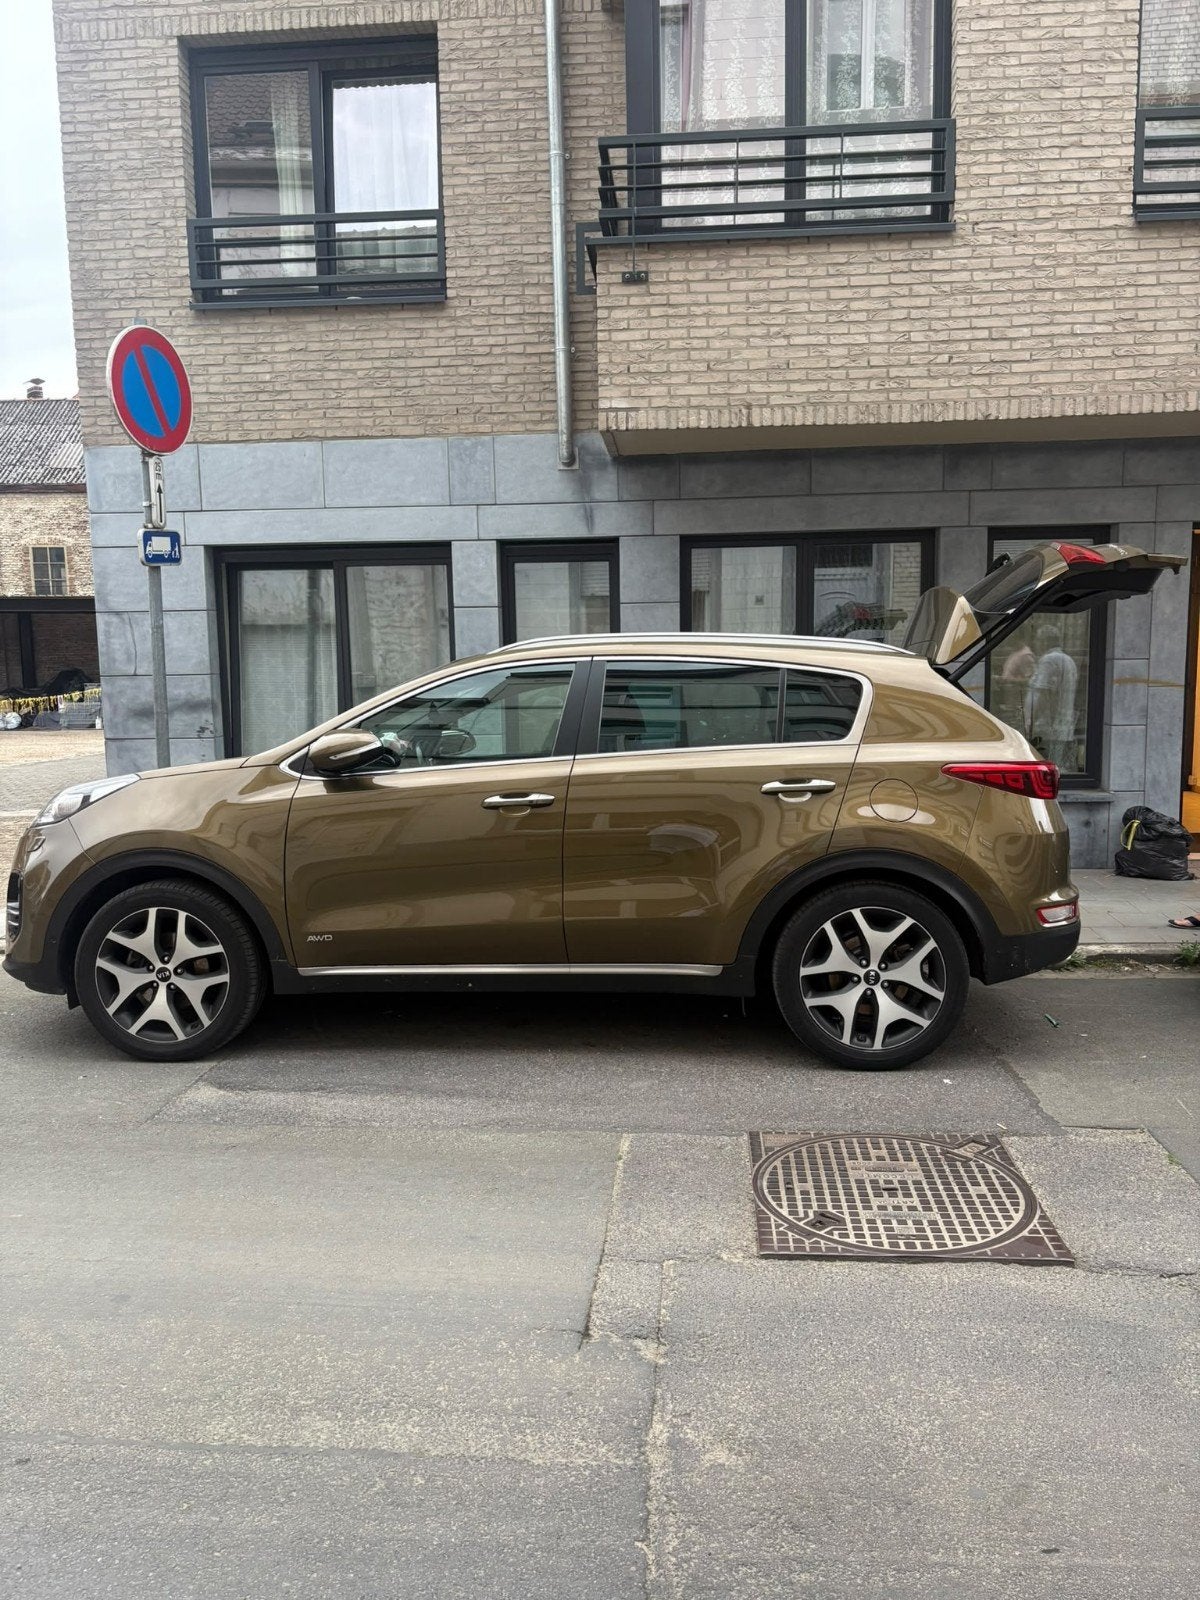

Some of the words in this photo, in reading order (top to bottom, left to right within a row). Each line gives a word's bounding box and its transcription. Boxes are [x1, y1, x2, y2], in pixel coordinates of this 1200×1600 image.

[154, 461, 162, 472] 25
[306, 934, 333, 942] AWD
[157, 970, 170, 979] KIA
[868, 971, 876, 985] KIA
